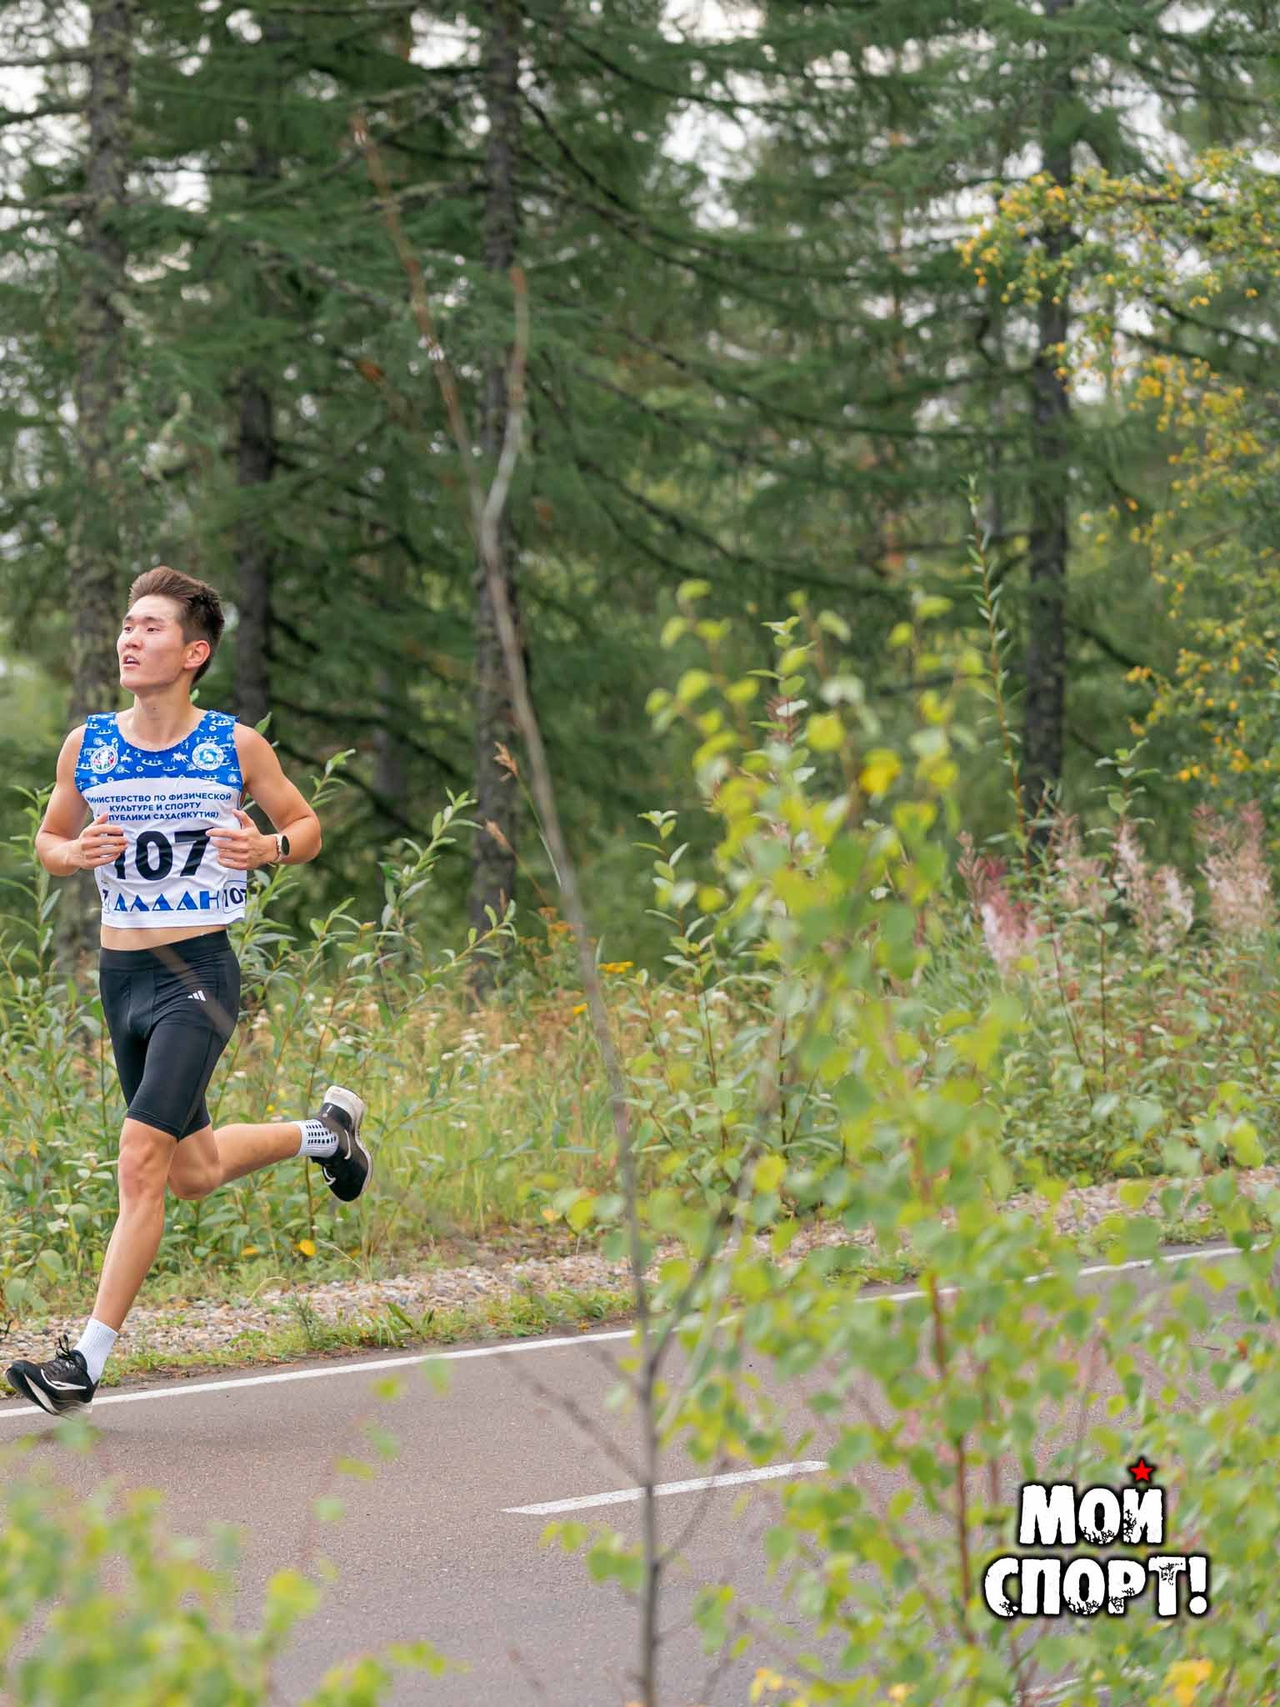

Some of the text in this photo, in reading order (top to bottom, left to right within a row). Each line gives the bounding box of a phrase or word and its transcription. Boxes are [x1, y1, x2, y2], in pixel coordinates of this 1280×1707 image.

[153, 794, 167, 802] ПО
[168, 792, 232, 802] ФИЗИЧЕСКОЙ
[109, 804, 154, 812] КУЛЬТУРЕ
[164, 802, 201, 811] СПОРТУ
[98, 811, 219, 821] ПУБЛИКИ САХА(ЯКУТИЯ)
[113, 890, 220, 912] АЛДАН
